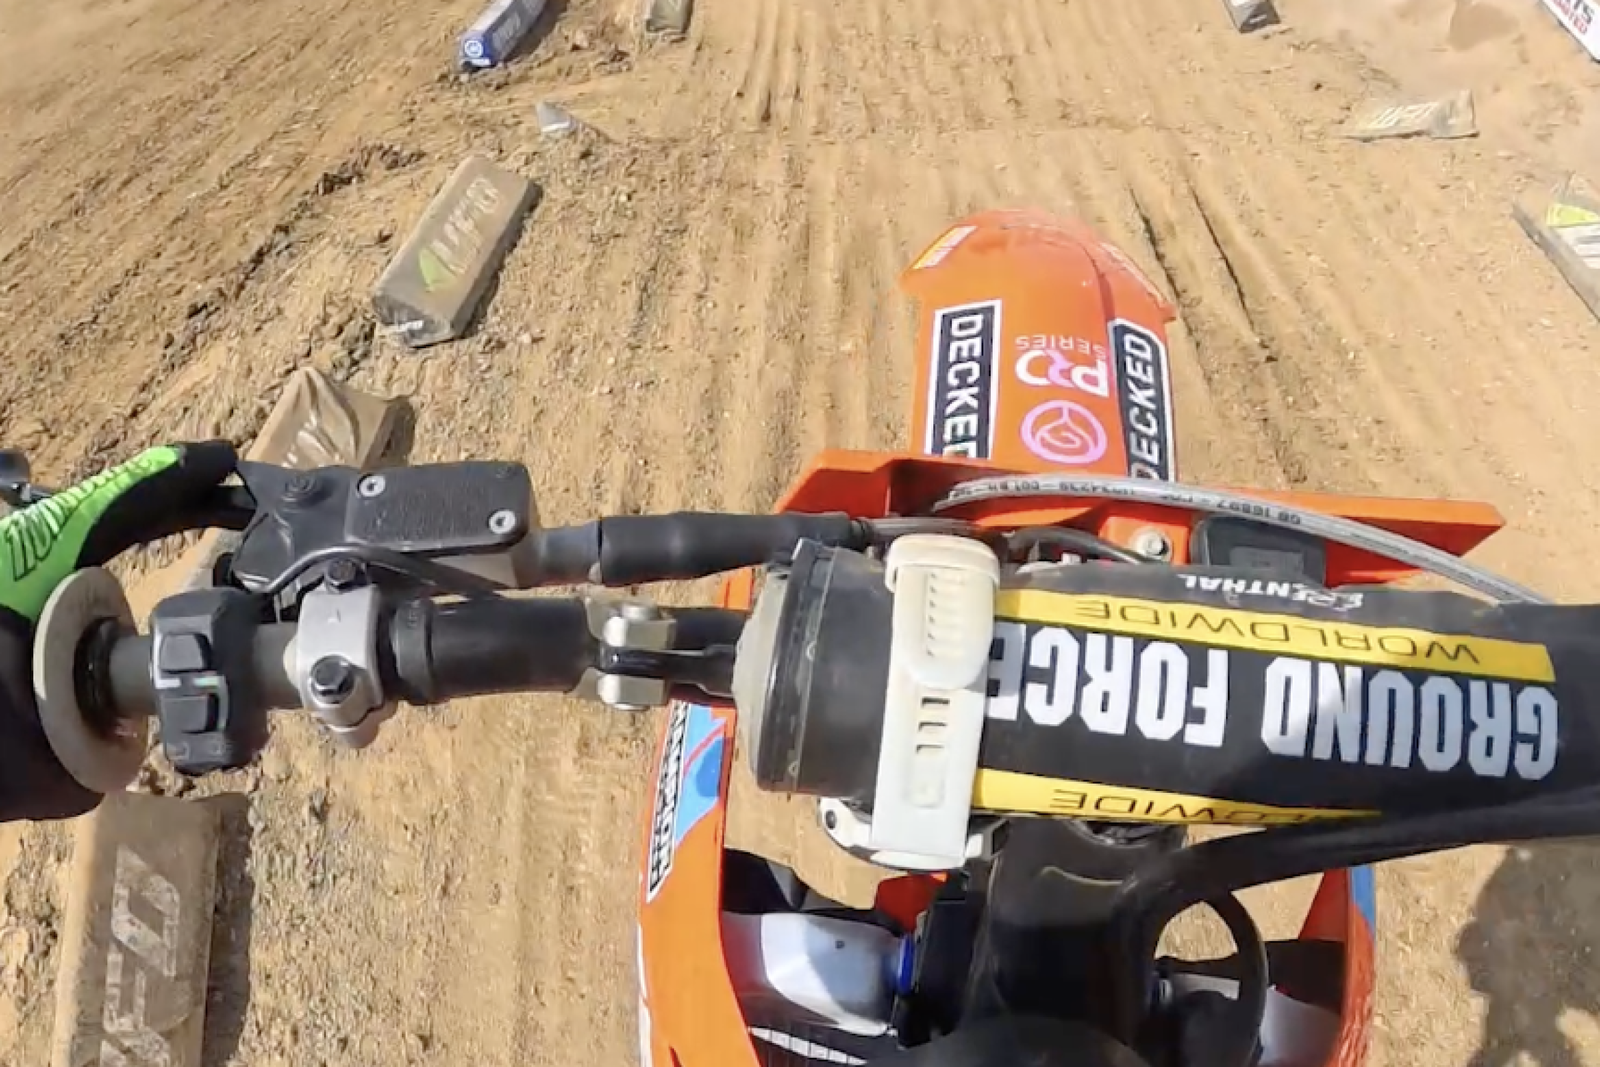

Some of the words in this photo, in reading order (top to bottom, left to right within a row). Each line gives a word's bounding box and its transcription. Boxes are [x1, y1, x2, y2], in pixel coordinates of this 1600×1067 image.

[1015, 349, 1109, 397] PRO
[1016, 335, 1107, 360] SERIES
[1074, 600, 1479, 664] WORLDWIDE
[986, 624, 1229, 747] FORCE
[1261, 656, 1559, 780] GROUND
